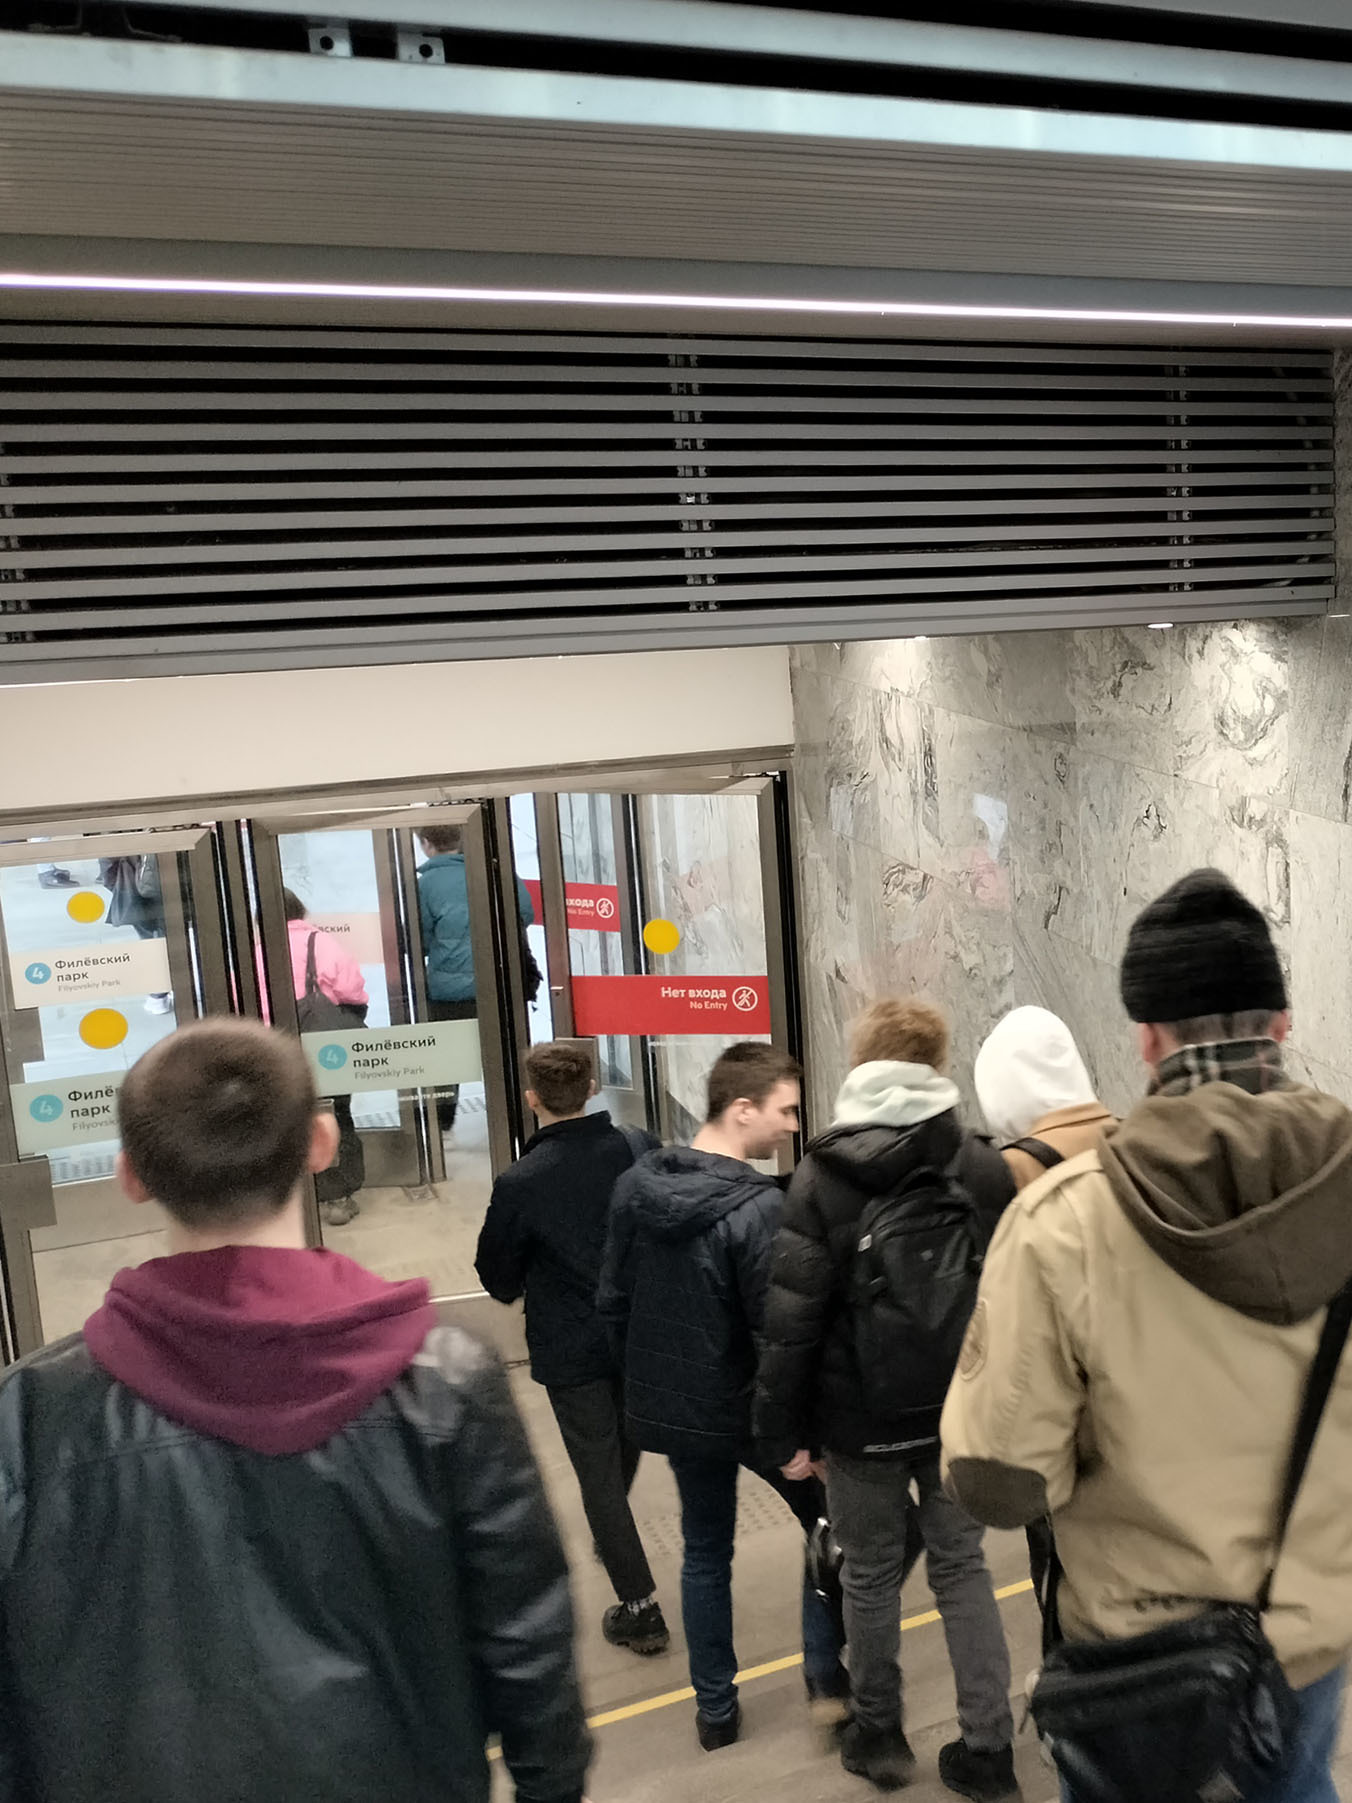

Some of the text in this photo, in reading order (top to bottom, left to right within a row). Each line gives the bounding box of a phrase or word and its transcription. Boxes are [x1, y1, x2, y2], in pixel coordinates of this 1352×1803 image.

[55, 953, 131, 970] Филёвский
[57, 971, 89, 983] парк
[101, 979, 121, 987] Park
[661, 986, 727, 1000] Нет входа
[690, 1001, 728, 1012] No Entry
[351, 1035, 436, 1053] Филёвский
[353, 1056, 389, 1069] парк
[403, 1065, 425, 1075] Park
[70, 1104, 111, 1119] парк
